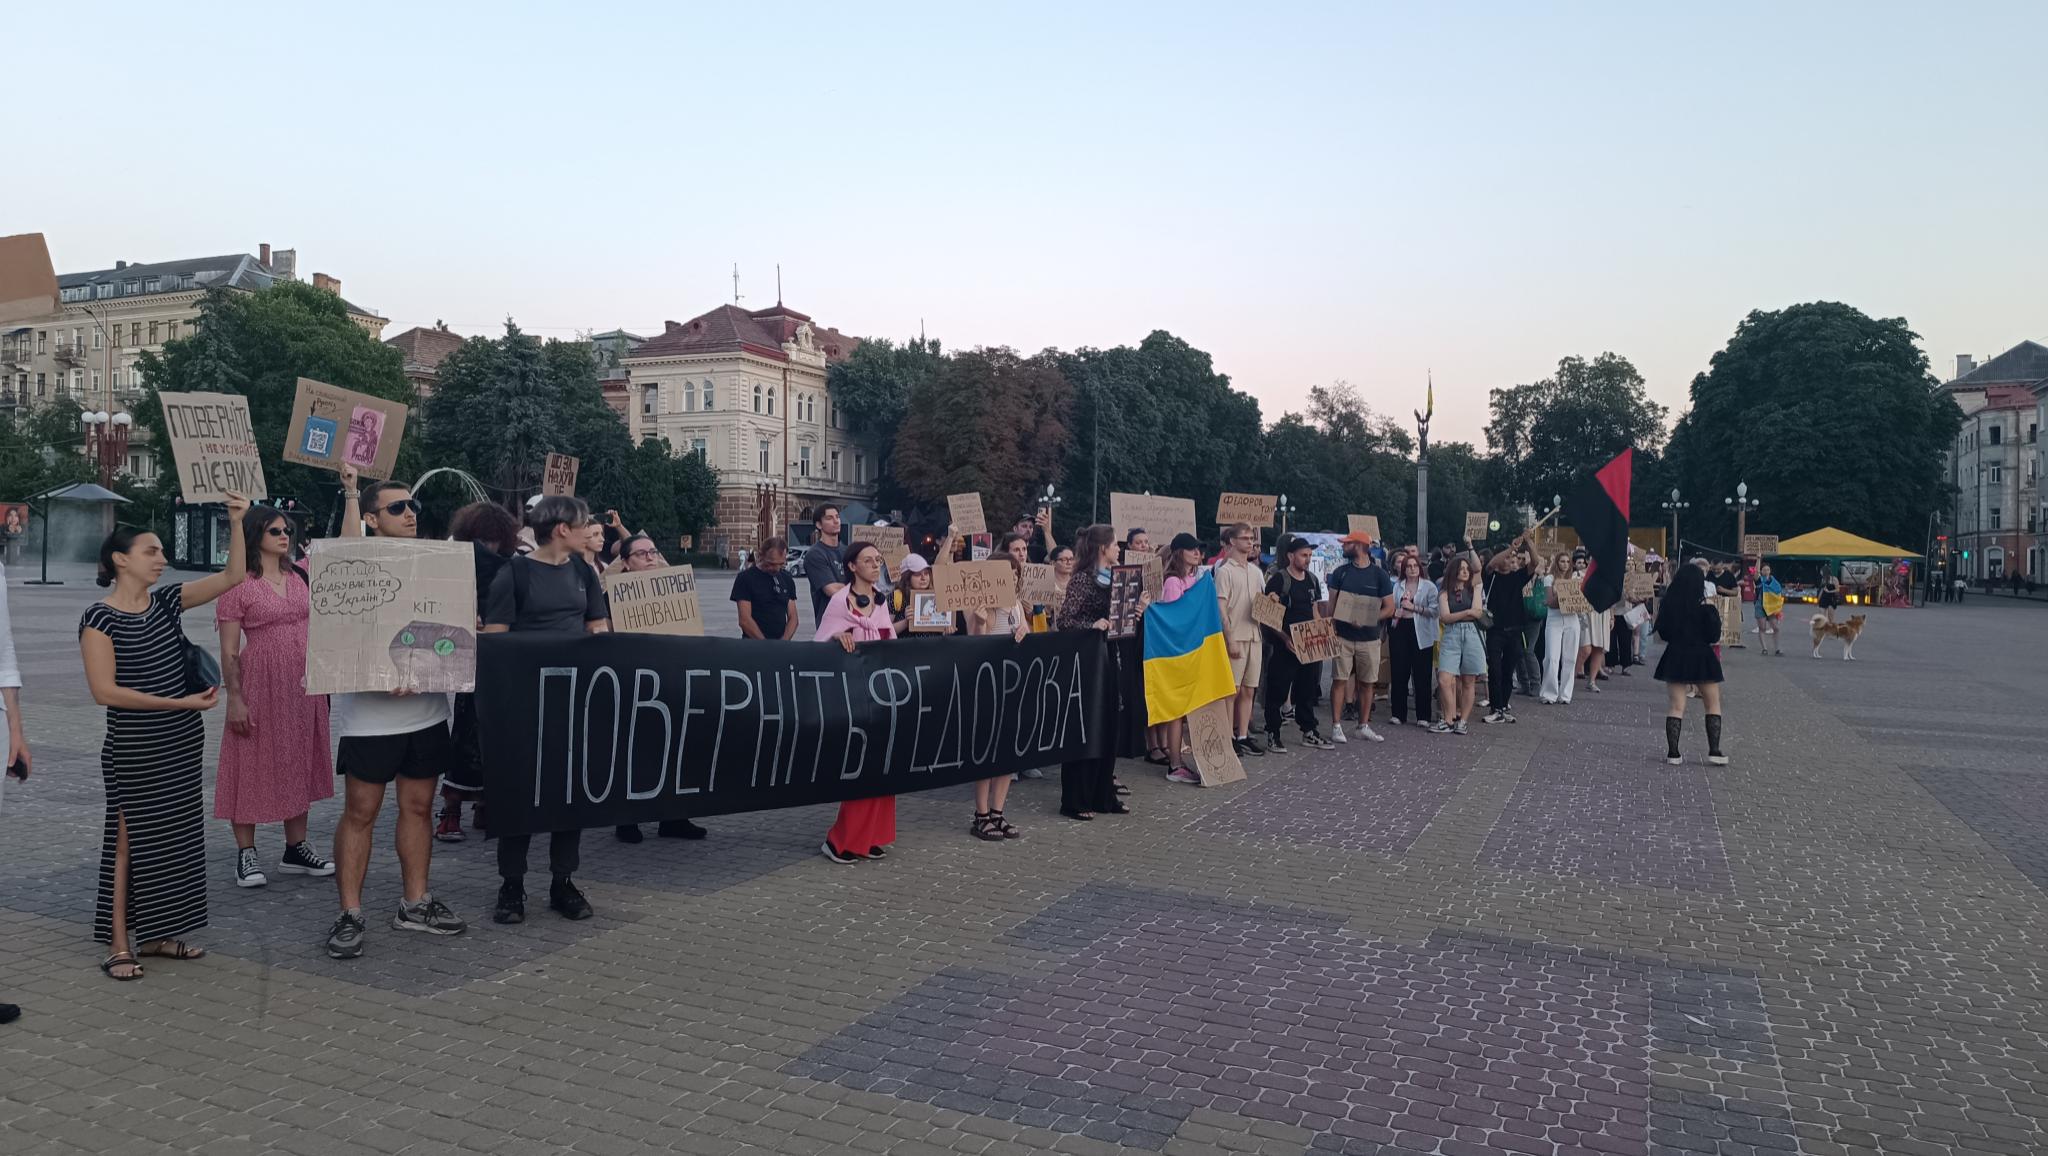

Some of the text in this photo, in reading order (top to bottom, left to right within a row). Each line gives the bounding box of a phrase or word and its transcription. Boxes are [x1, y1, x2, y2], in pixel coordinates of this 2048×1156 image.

[167, 401, 256, 443] ПОВЕРНІТЬ
[206, 443, 219, 455] НЕ
[220, 442, 261, 459] УСУВАЙТЕ
[191, 456, 265, 495] ДІЄВИХ
[1223, 495, 1263, 507] ФЕДОРОВ
[613, 572, 696, 603] АРМІЇ ПОТРІБНІ
[996, 578, 1007, 586] НА
[533, 664, 868, 808] ПОВЕРНІТЬ
[868, 651, 1087, 775] ФЕДОРОВА
